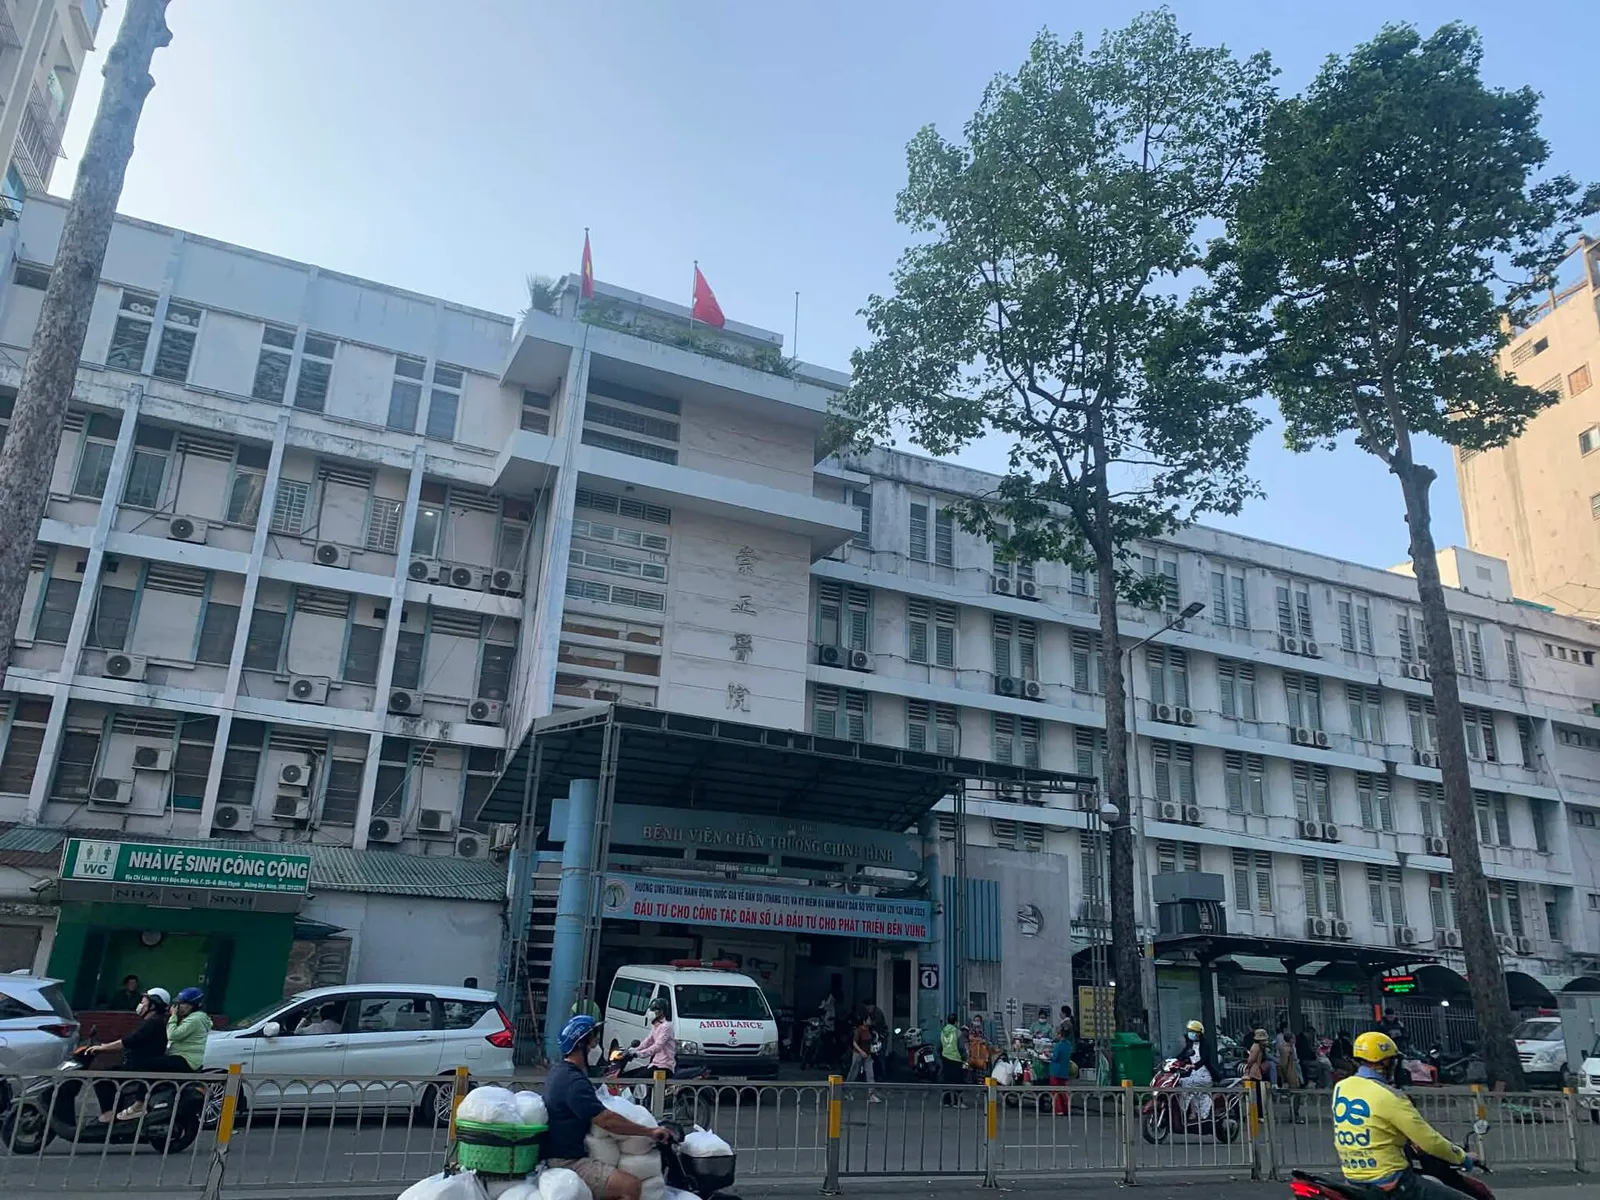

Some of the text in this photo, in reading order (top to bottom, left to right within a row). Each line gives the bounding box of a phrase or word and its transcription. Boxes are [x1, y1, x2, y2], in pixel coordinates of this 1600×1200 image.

[83, 863, 108, 875] WC
[129, 848, 308, 881] NHÀ VỆ SINH CÔNG CỘNG
[671, 904, 690, 919] CHO
[692, 904, 717, 921] CÔNG
[819, 916, 836, 931] CHO
[699, 1020, 764, 1030] AMBULANCE
[1334, 1086, 1371, 1126] be
